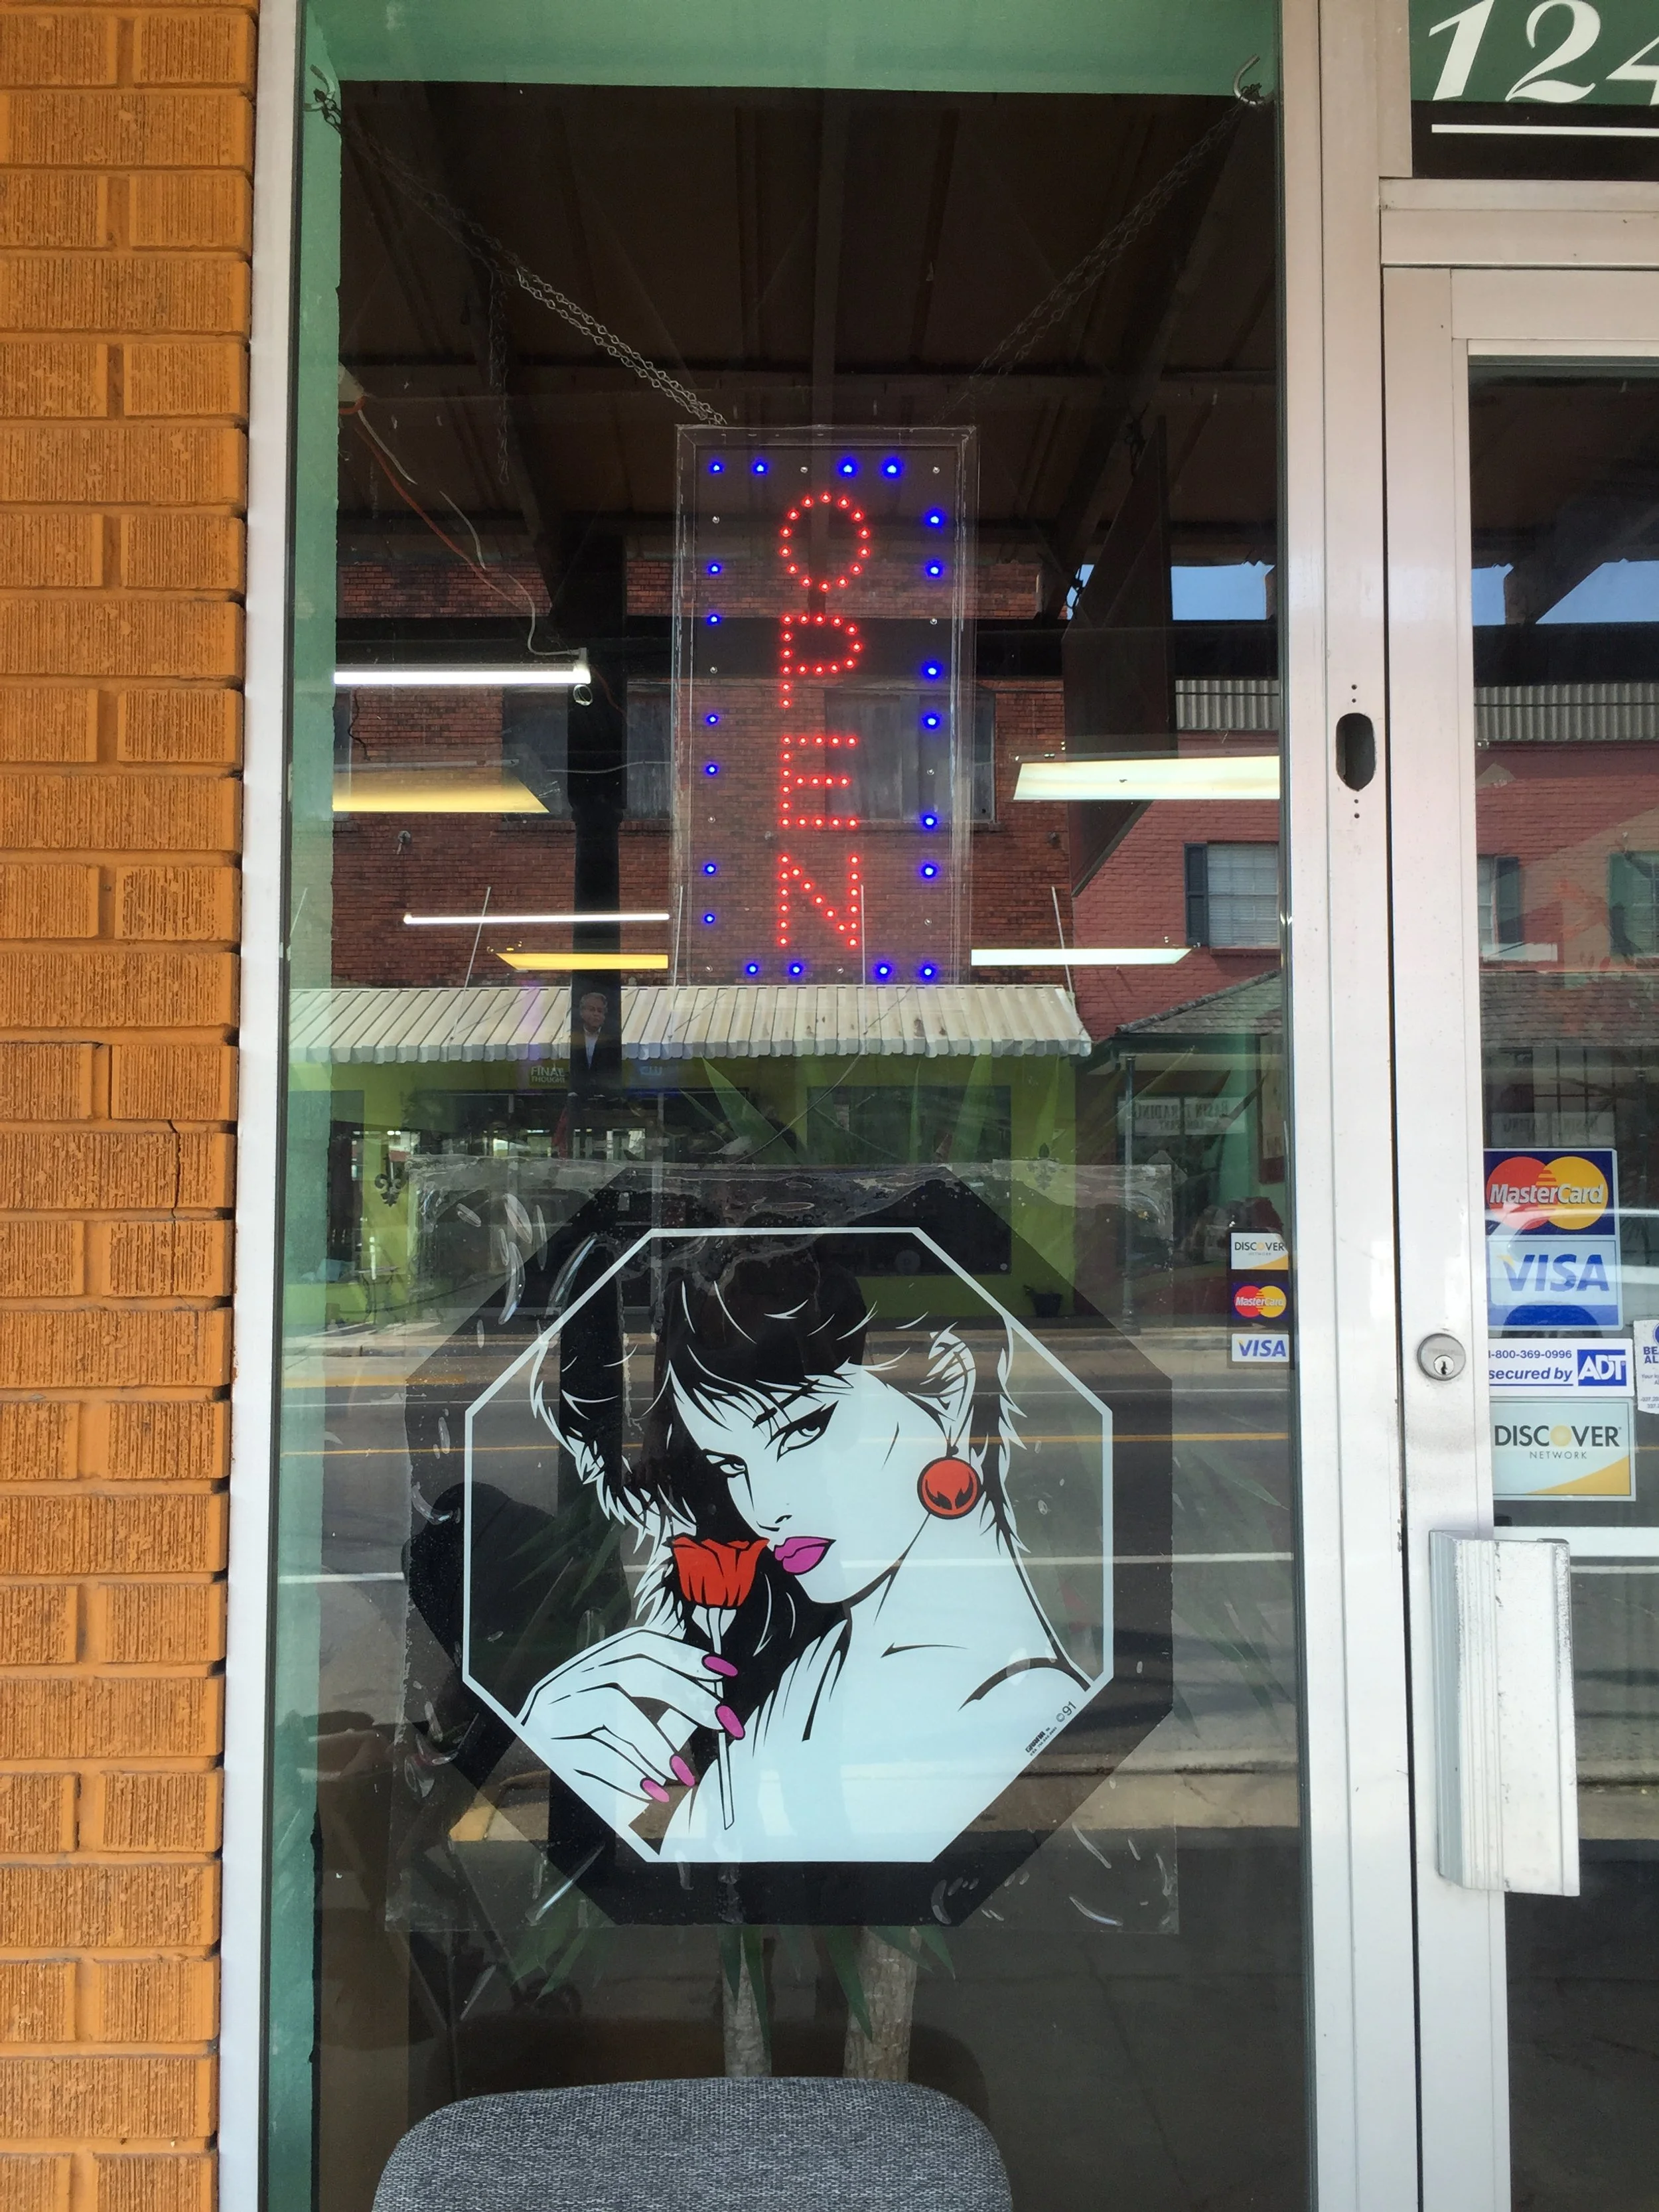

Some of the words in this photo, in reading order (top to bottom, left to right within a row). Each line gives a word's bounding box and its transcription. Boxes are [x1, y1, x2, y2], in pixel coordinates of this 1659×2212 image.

[778, 492, 871, 948] OPEN
[531, 1066, 565, 1076] FINAL
[1489, 1183, 1603, 1205] MasterCard
[1234, 1242, 1285, 1251] DISCOVER
[1497, 1254, 1610, 1291] VISA
[1235, 1296, 1284, 1306] MasterCard
[1238, 1339, 1287, 1357] VISA
[1488, 1350, 1572, 1359] 1-800-369-0996
[1643, 1346, 1659, 1355] BE
[1488, 1367, 1551, 1380] secured
[1553, 1367, 1573, 1382] by
[1578, 1355, 1626, 1380] ADT
[1494, 1424, 1620, 1447] DISCOVER
[1530, 1451, 1587, 1459] NETWORK
